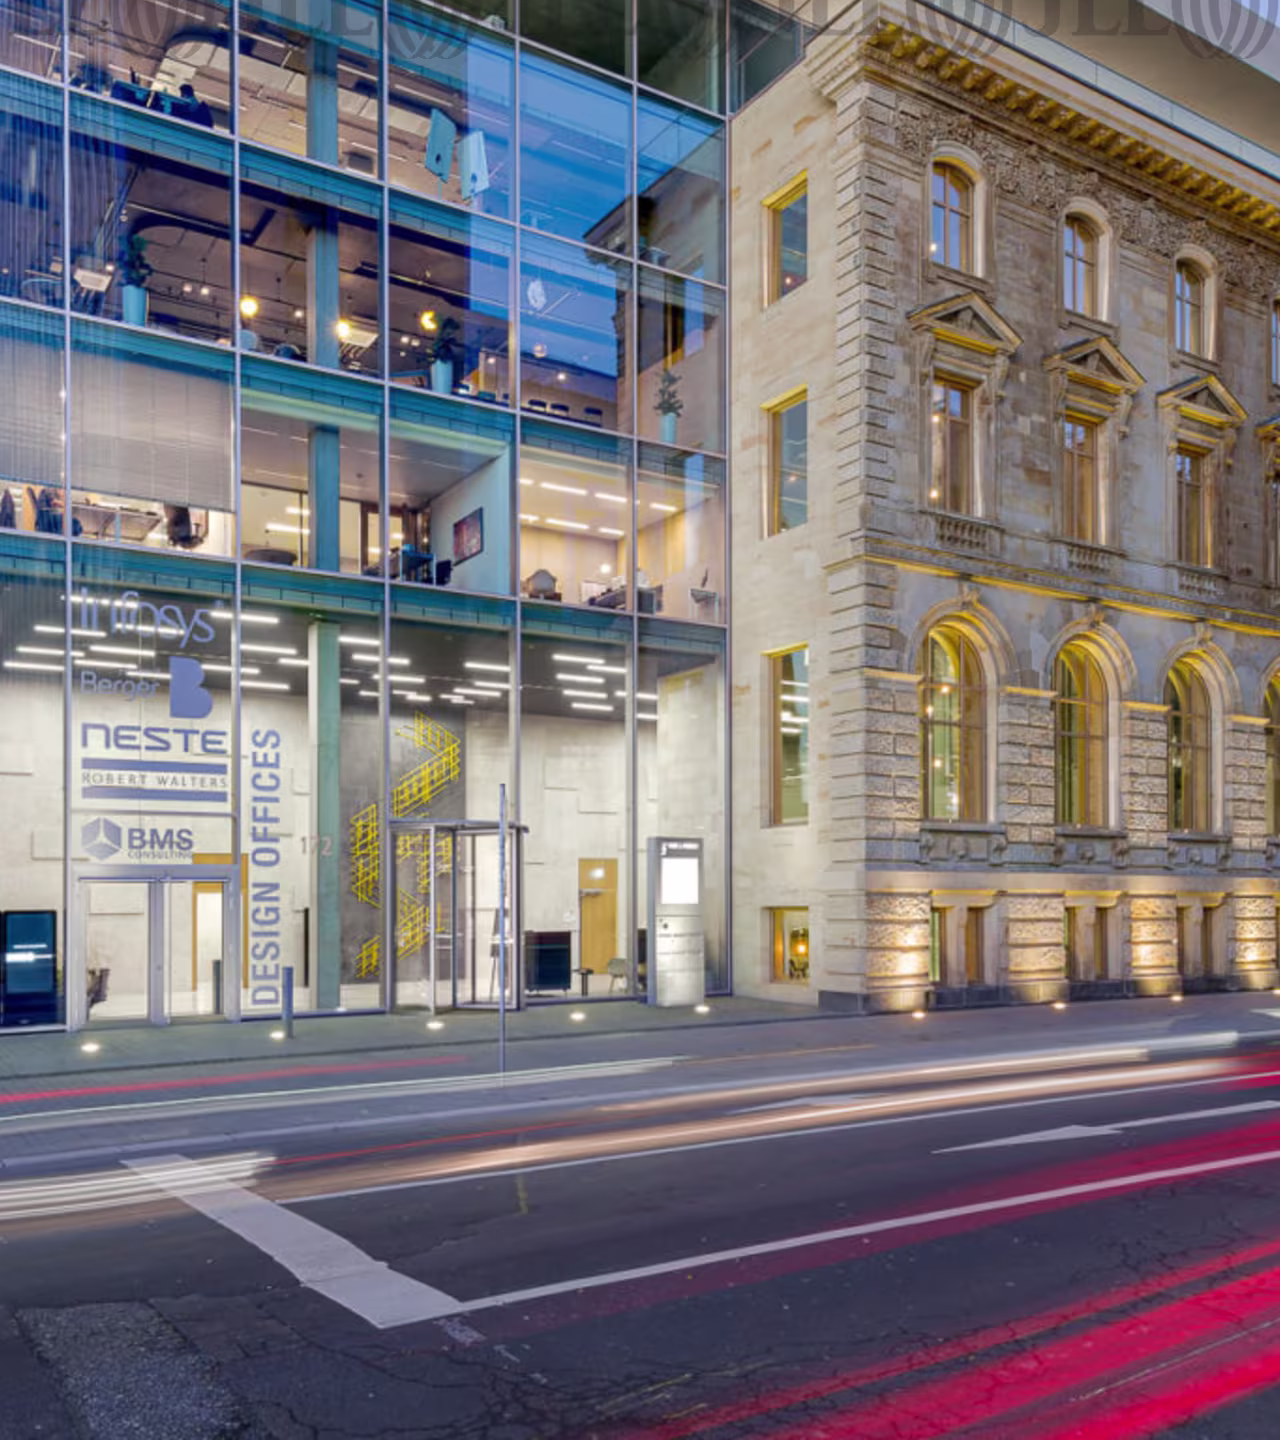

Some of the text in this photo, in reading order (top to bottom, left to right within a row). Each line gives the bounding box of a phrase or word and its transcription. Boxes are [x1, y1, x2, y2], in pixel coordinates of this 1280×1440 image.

[81, 587, 215, 648] Infosys
[81, 670, 160, 702] Berger
[81, 722, 228, 755] NESTE
[81, 771, 228, 789] ROBERT WALTERS
[127, 828, 194, 851] BMS
[251, 729, 280, 1006] DESIGN OFFICES
